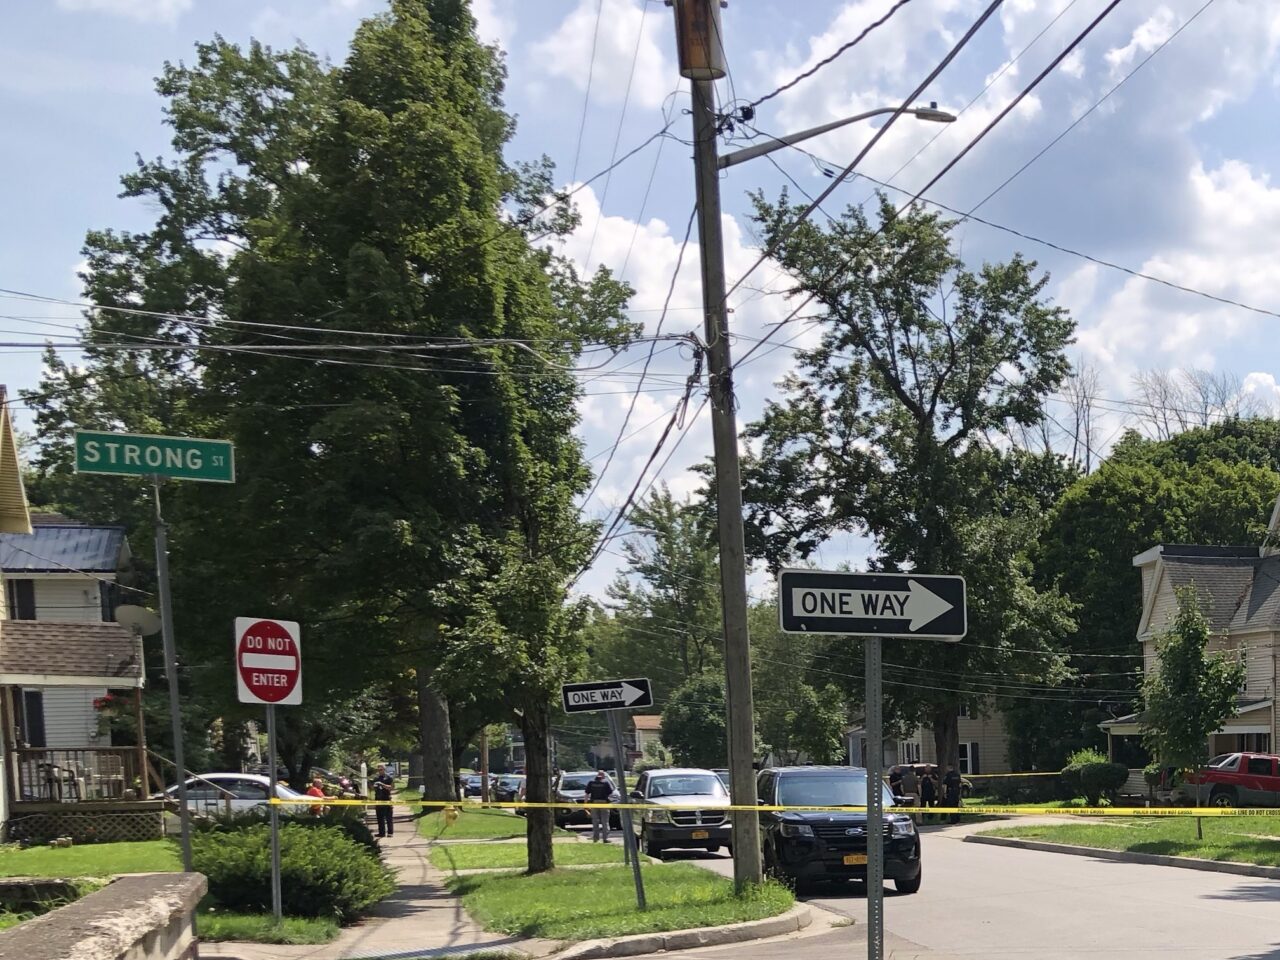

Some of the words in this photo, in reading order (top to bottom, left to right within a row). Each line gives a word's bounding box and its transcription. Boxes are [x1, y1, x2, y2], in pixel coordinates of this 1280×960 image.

[83, 440, 203, 470] STRONG
[211, 455, 224, 467] ST
[801, 591, 853, 615] ONE
[860, 593, 910, 616] WAY
[247, 636, 263, 649] DO
[268, 637, 291, 651] NOT
[252, 672, 288, 687] ENTER
[572, 691, 598, 704] ONE
[600, 689, 624, 701] WAY
